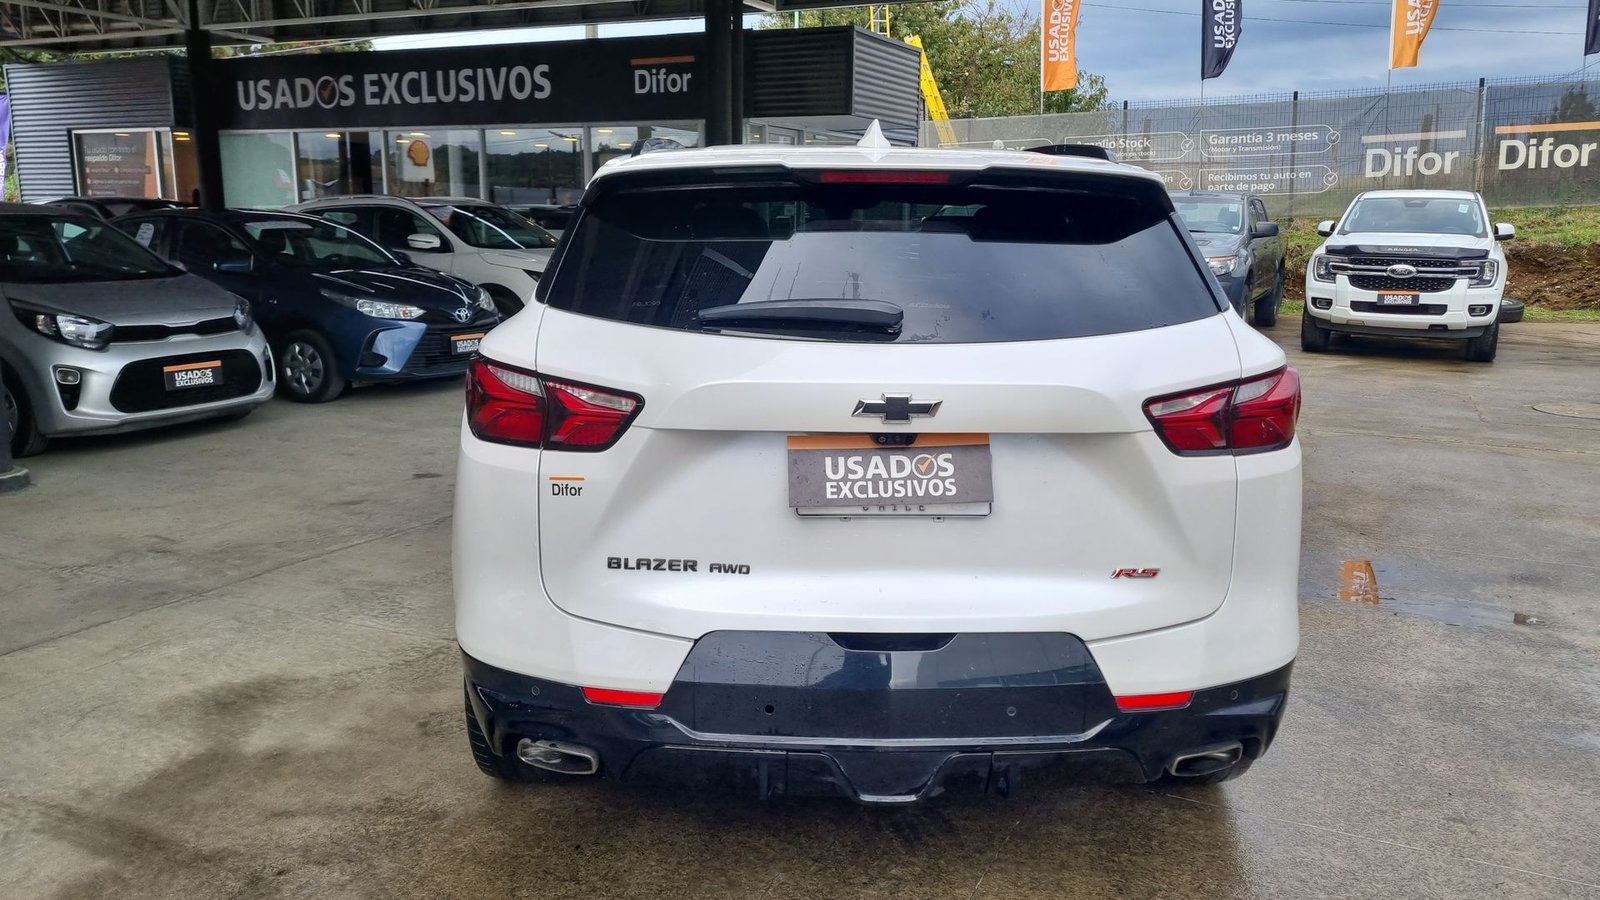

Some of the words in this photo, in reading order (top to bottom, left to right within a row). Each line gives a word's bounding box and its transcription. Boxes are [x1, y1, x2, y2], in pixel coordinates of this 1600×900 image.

[1049, 0, 1064, 61] USADO
[1060, 0, 1073, 61] EXCLUSIV
[1213, 0, 1225, 48] USAD
[237, 75, 356, 111] USADOS
[364, 64, 552, 106] EXCLUSIVOS
[633, 69, 693, 95] Difor
[1118, 137, 1152, 149] Stock
[1209, 132, 1263, 145] Garantía
[1266, 132, 1274, 143] 3
[1277, 131, 1319, 141] meses
[1365, 146, 1459, 178] Difor
[1498, 137, 1598, 170] Difor
[1208, 173, 1257, 181] Recibimos
[1260, 172, 1270, 180] tu
[1273, 171, 1297, 180] auto
[1208, 182, 1234, 190] parte
[1236, 182, 1249, 190] de
[1250, 182, 1275, 192] pago
[175, 369, 213, 380] USADOS
[176, 377, 213, 387] EXCLUSIVOS
[825, 453, 955, 480] USADOS
[551, 483, 583, 496] Difor
[826, 478, 957, 499] EXCLUSIVOS
[607, 556, 698, 572] BLAZER
[709, 562, 750, 575] AWD
[1111, 568, 1160, 579] RS
